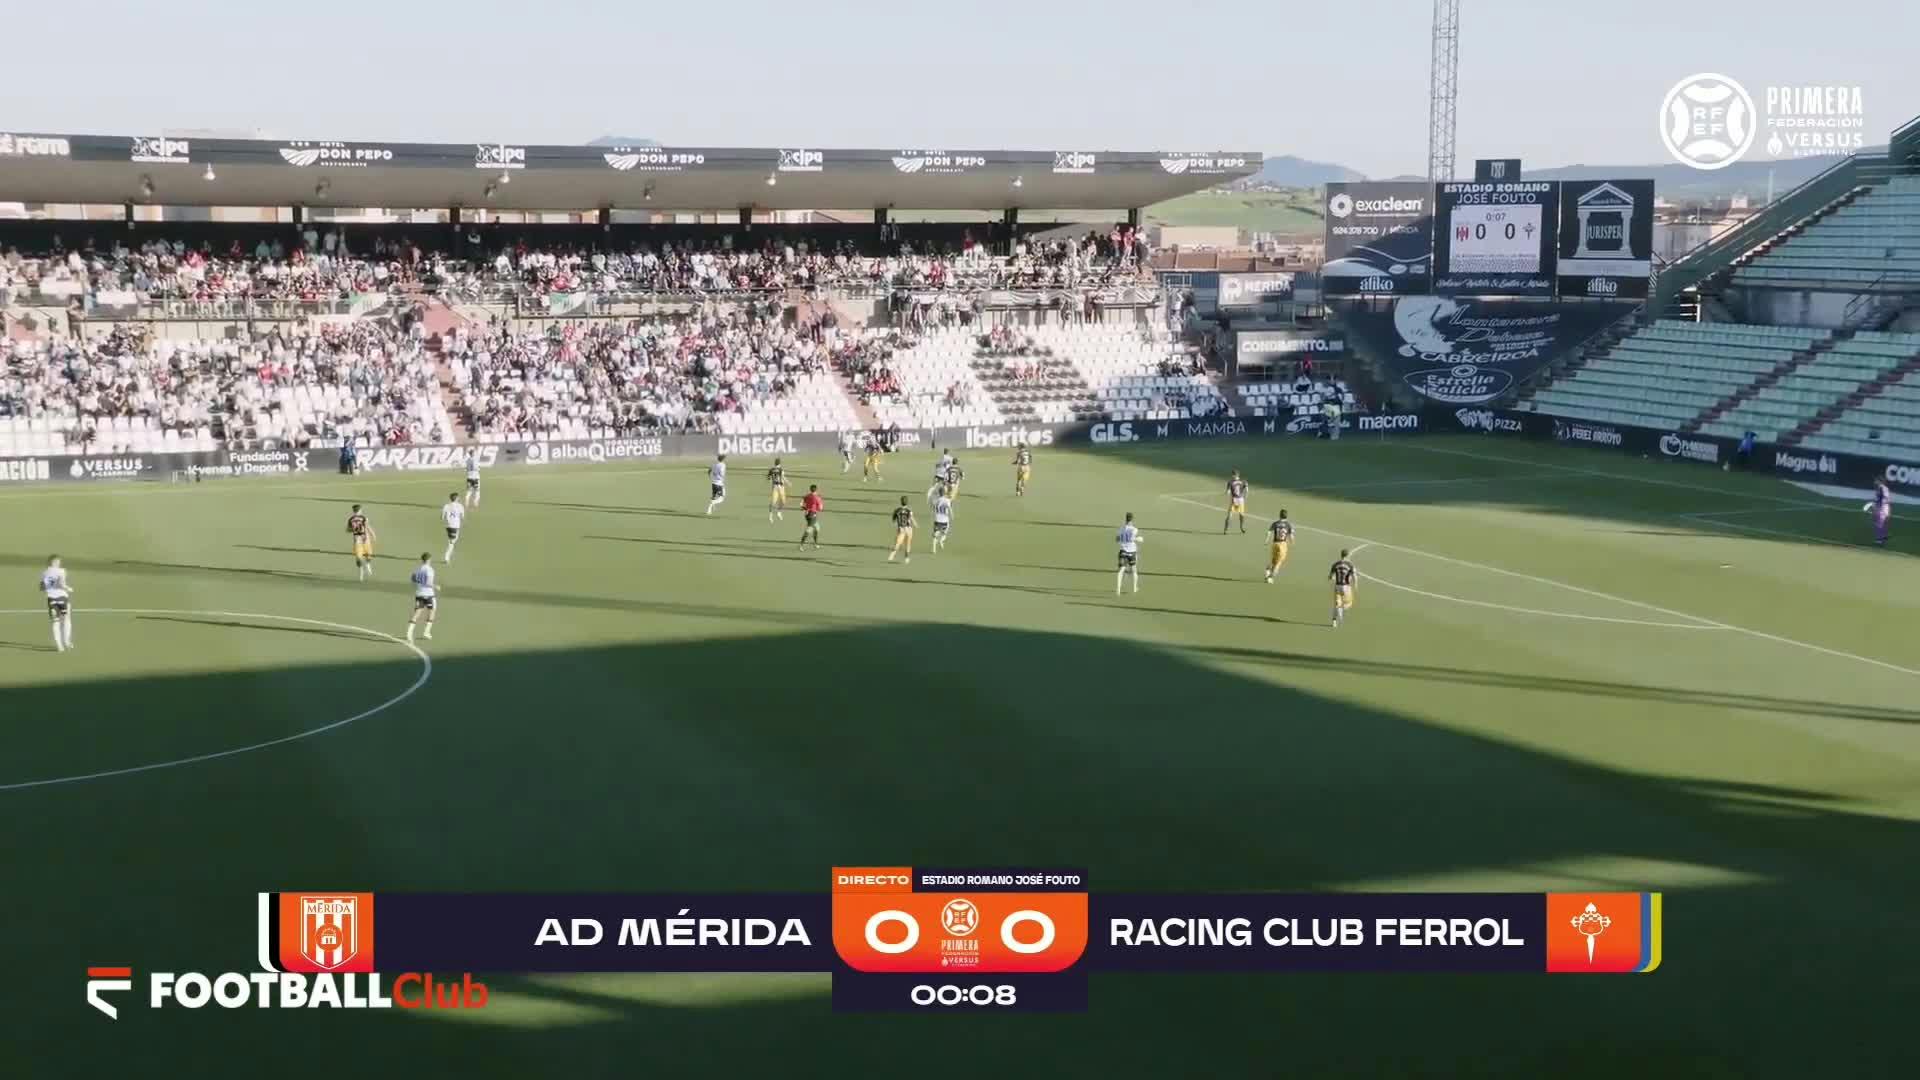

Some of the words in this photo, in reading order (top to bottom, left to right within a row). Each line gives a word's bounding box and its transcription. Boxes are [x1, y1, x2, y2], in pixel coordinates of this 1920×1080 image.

[1444, 183, 1494, 193] ESTADIO
[1496, 183, 1550, 192] ROMANO
[1355, 196, 1422, 211] exaclean
[1457, 191, 1489, 204] JOSÉ
[1492, 193, 1537, 203] FOUTO
[1188, 421, 1246, 436] MAMBA
[1359, 414, 1418, 429] macron
[1494, 418, 1522, 432] PIZZA
[966, 426, 1053, 448] Iberitos
[230, 450, 289, 462] Fundación
[1775, 452, 1817, 472] Magna
[84, 458, 142, 472] VERSUS
[244, 462, 289, 474] Deporte
